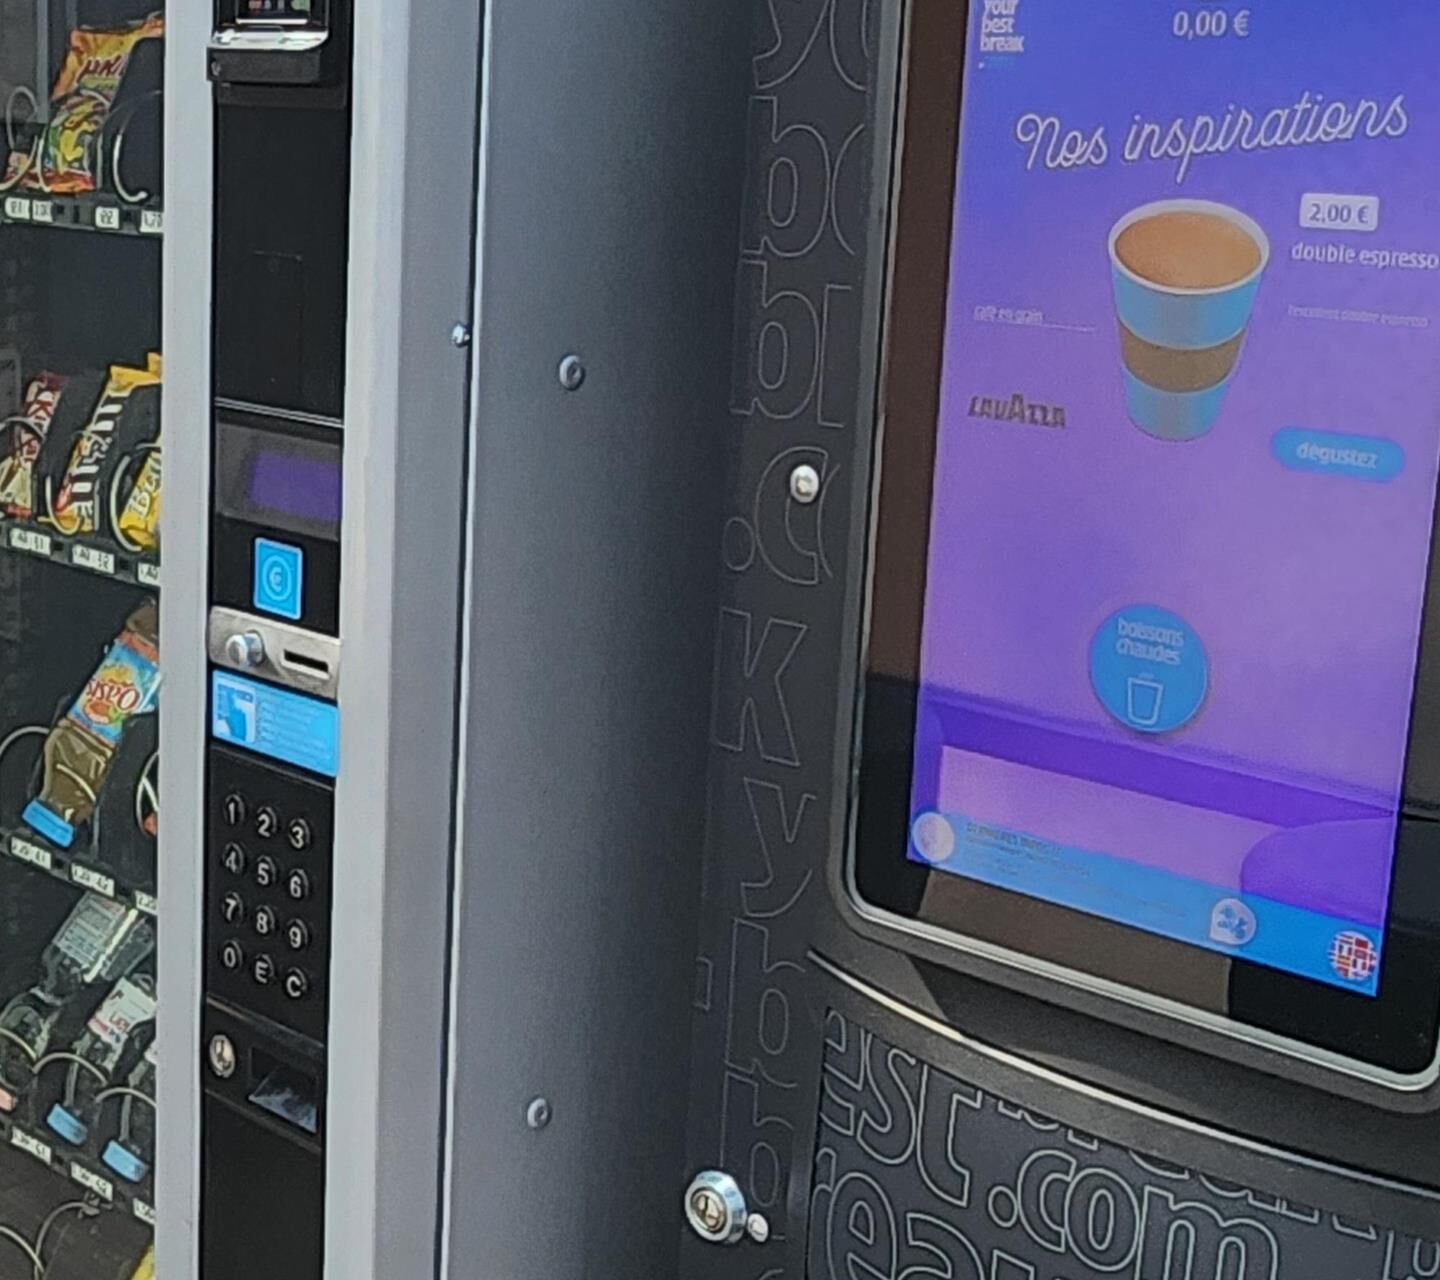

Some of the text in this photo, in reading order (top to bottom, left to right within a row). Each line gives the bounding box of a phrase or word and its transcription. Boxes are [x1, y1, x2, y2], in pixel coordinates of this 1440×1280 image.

[979, 34, 1025, 52] break
[981, 15, 1016, 34] best
[1172, 10, 1251, 41] 0,00 €
[1015, 88, 1409, 184] Nos inspirations
[1291, 241, 1440, 270] double espresso
[967, 392, 1068, 430] LAVAZZA
[1115, 637, 1182, 667] chaudes
[257, 813, 272, 838] 2
[291, 826, 305, 850] 3
[225, 851, 301, 899] 4 5 6
[224, 898, 302, 949] 7 8 9
[223, 946, 302, 998] 0 E C
